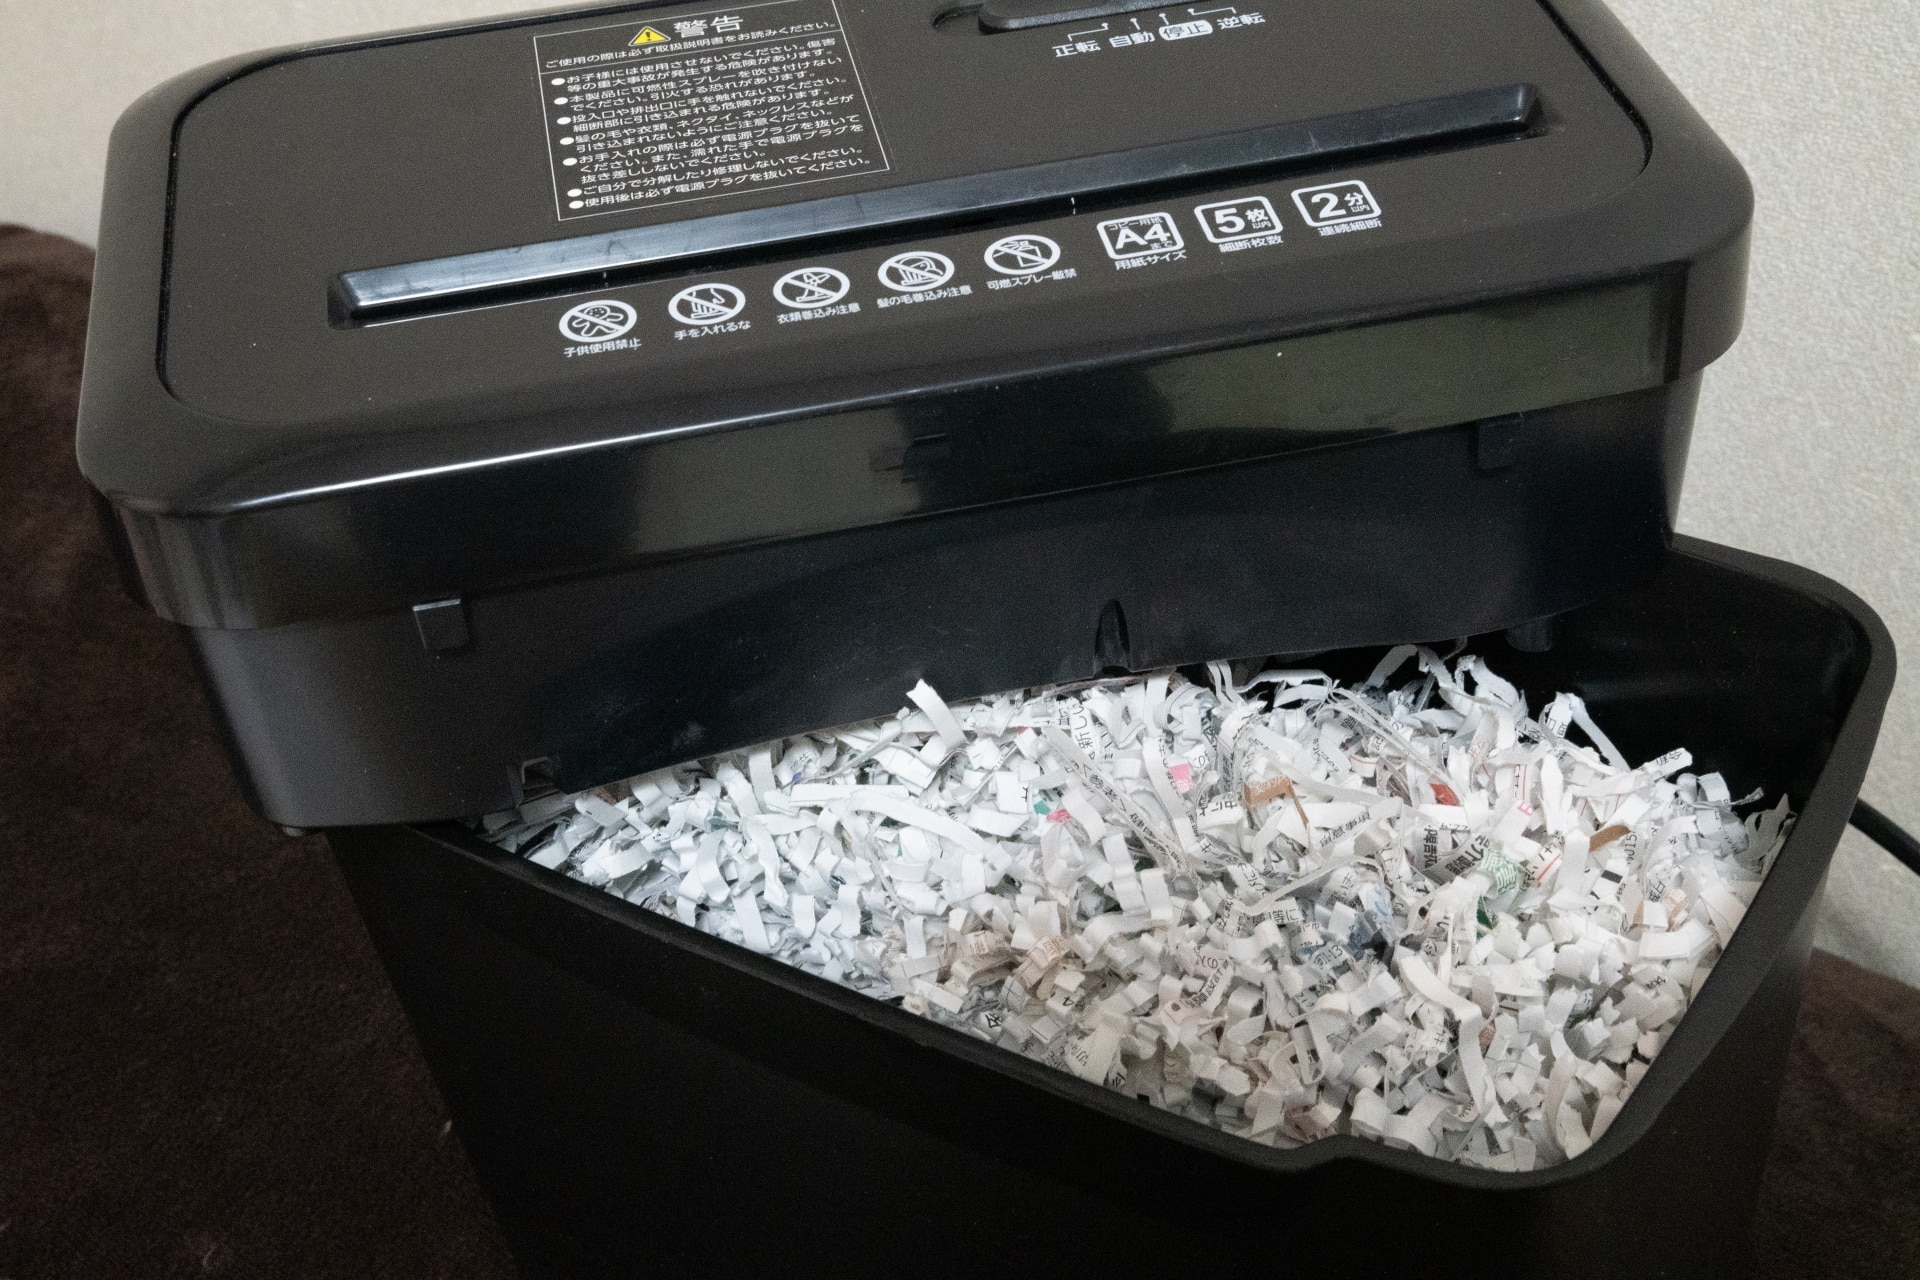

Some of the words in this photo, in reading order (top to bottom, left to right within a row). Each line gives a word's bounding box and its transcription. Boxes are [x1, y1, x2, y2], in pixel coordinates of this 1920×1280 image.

[546, 21, 835, 68] ご使用の際は必ず取扱説明書をお読みください。
[673, 15, 743, 38] 警告
[1052, 40, 1101, 57] 正転
[1109, 32, 1155, 48] 自動
[1163, 22, 1209, 38] 停止
[1217, 12, 1266, 29] 逆転
[567, 37, 836, 84] お子様には使用させないでください。傷害
[567, 48, 832, 93] 等の重大事故が発生する危険があります。
[570, 57, 842, 103] 本製品に可燃性スプレーを吹き付けない
[571, 71, 815, 111] でください。引火する恐れがあります。
[571, 77, 847, 124] 投入口や排出口に手を触れないでください。
[573, 89, 829, 132] 細断部に引き込まれる危険があります。
[575, 94, 854, 143] 髪の毛や衣類、ネクタイ、ネックレスなどが
[576, 109, 832, 153] 引き込まれないようにご注意ください。
[579, 114, 860, 164] お手入れの際は必ず電源プラグを抜いて
[581, 150, 765, 184] 抜き差ししないでください。
[583, 147, 862, 195] ご自分で分解したり修理しないでください。
[585, 158, 870, 207] 使用後は必ず電源プラグを抜いてください。
[1107, 216, 1163, 231] コピー用紙
[1115, 223, 1171, 250] A4
[1318, 218, 1382, 236] 連続細断
[1115, 249, 1187, 270] 用紙サイズ
[1150, 240, 1174, 250] まで
[1219, 235, 1284, 253] 細断枚数
[876, 285, 973, 309] 髪の毛巻込み注意
[986, 268, 1077, 290] 可燃スプレー厳禁
[674, 321, 751, 341] 手を入れるな
[777, 302, 861, 324] 衣類巻込み注意
[563, 337, 642, 358] 子供使用禁止
